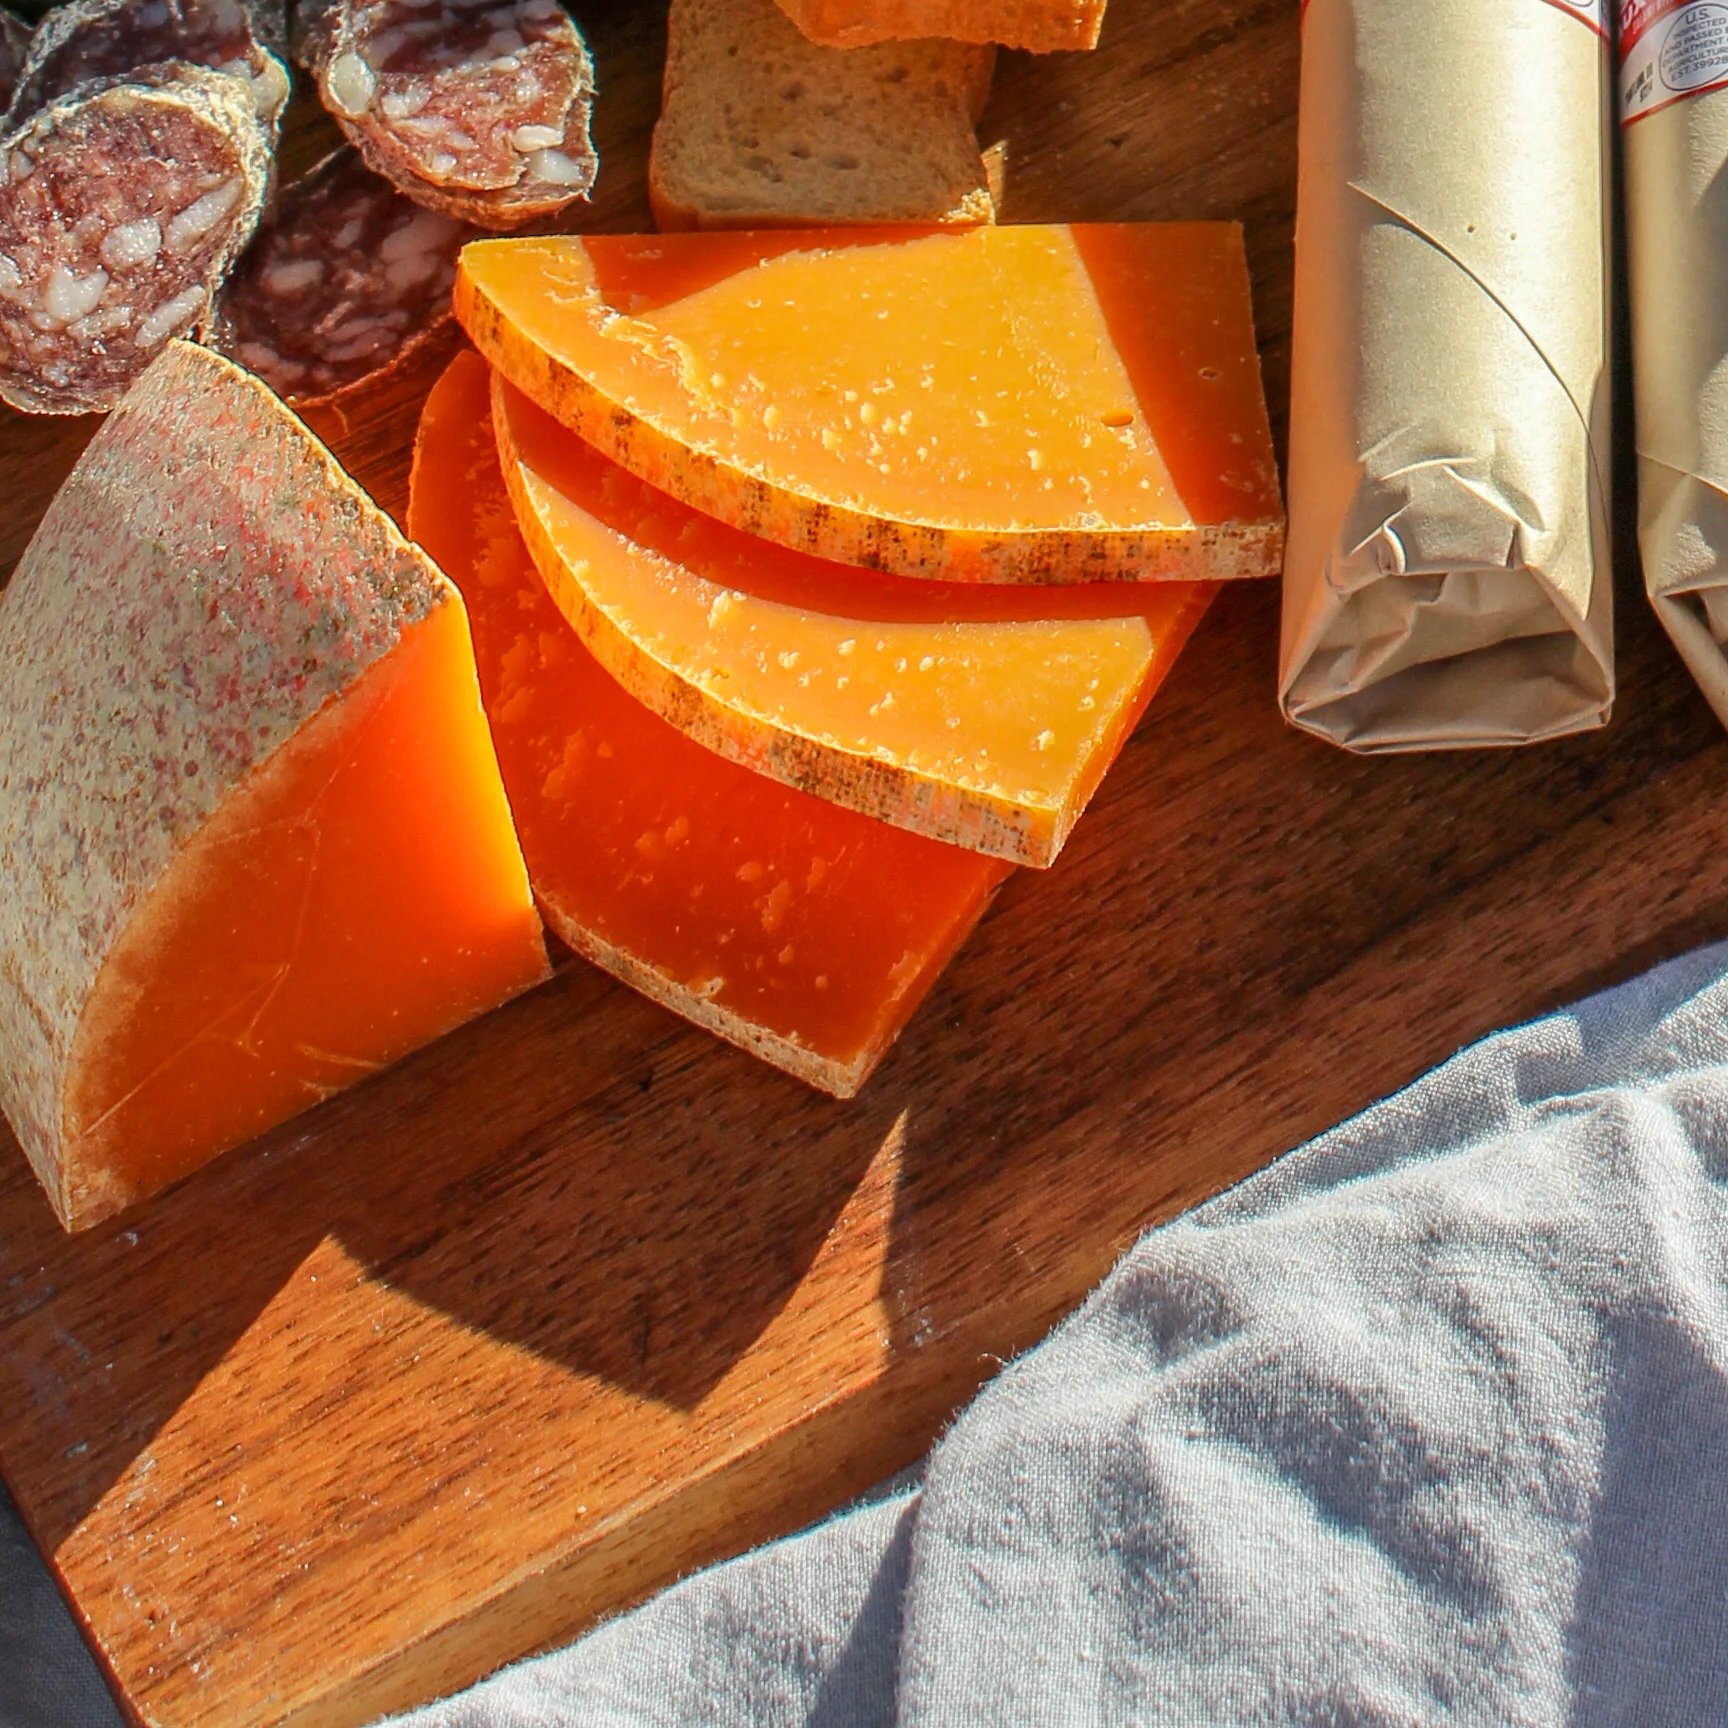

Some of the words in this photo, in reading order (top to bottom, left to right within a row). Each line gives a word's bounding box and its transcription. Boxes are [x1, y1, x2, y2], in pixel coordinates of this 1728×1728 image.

[1684, 7, 1711, 26] U.S.
[1672, 17, 1728, 40] INSPECTED
[1683, 28, 1722, 46] PASSED
